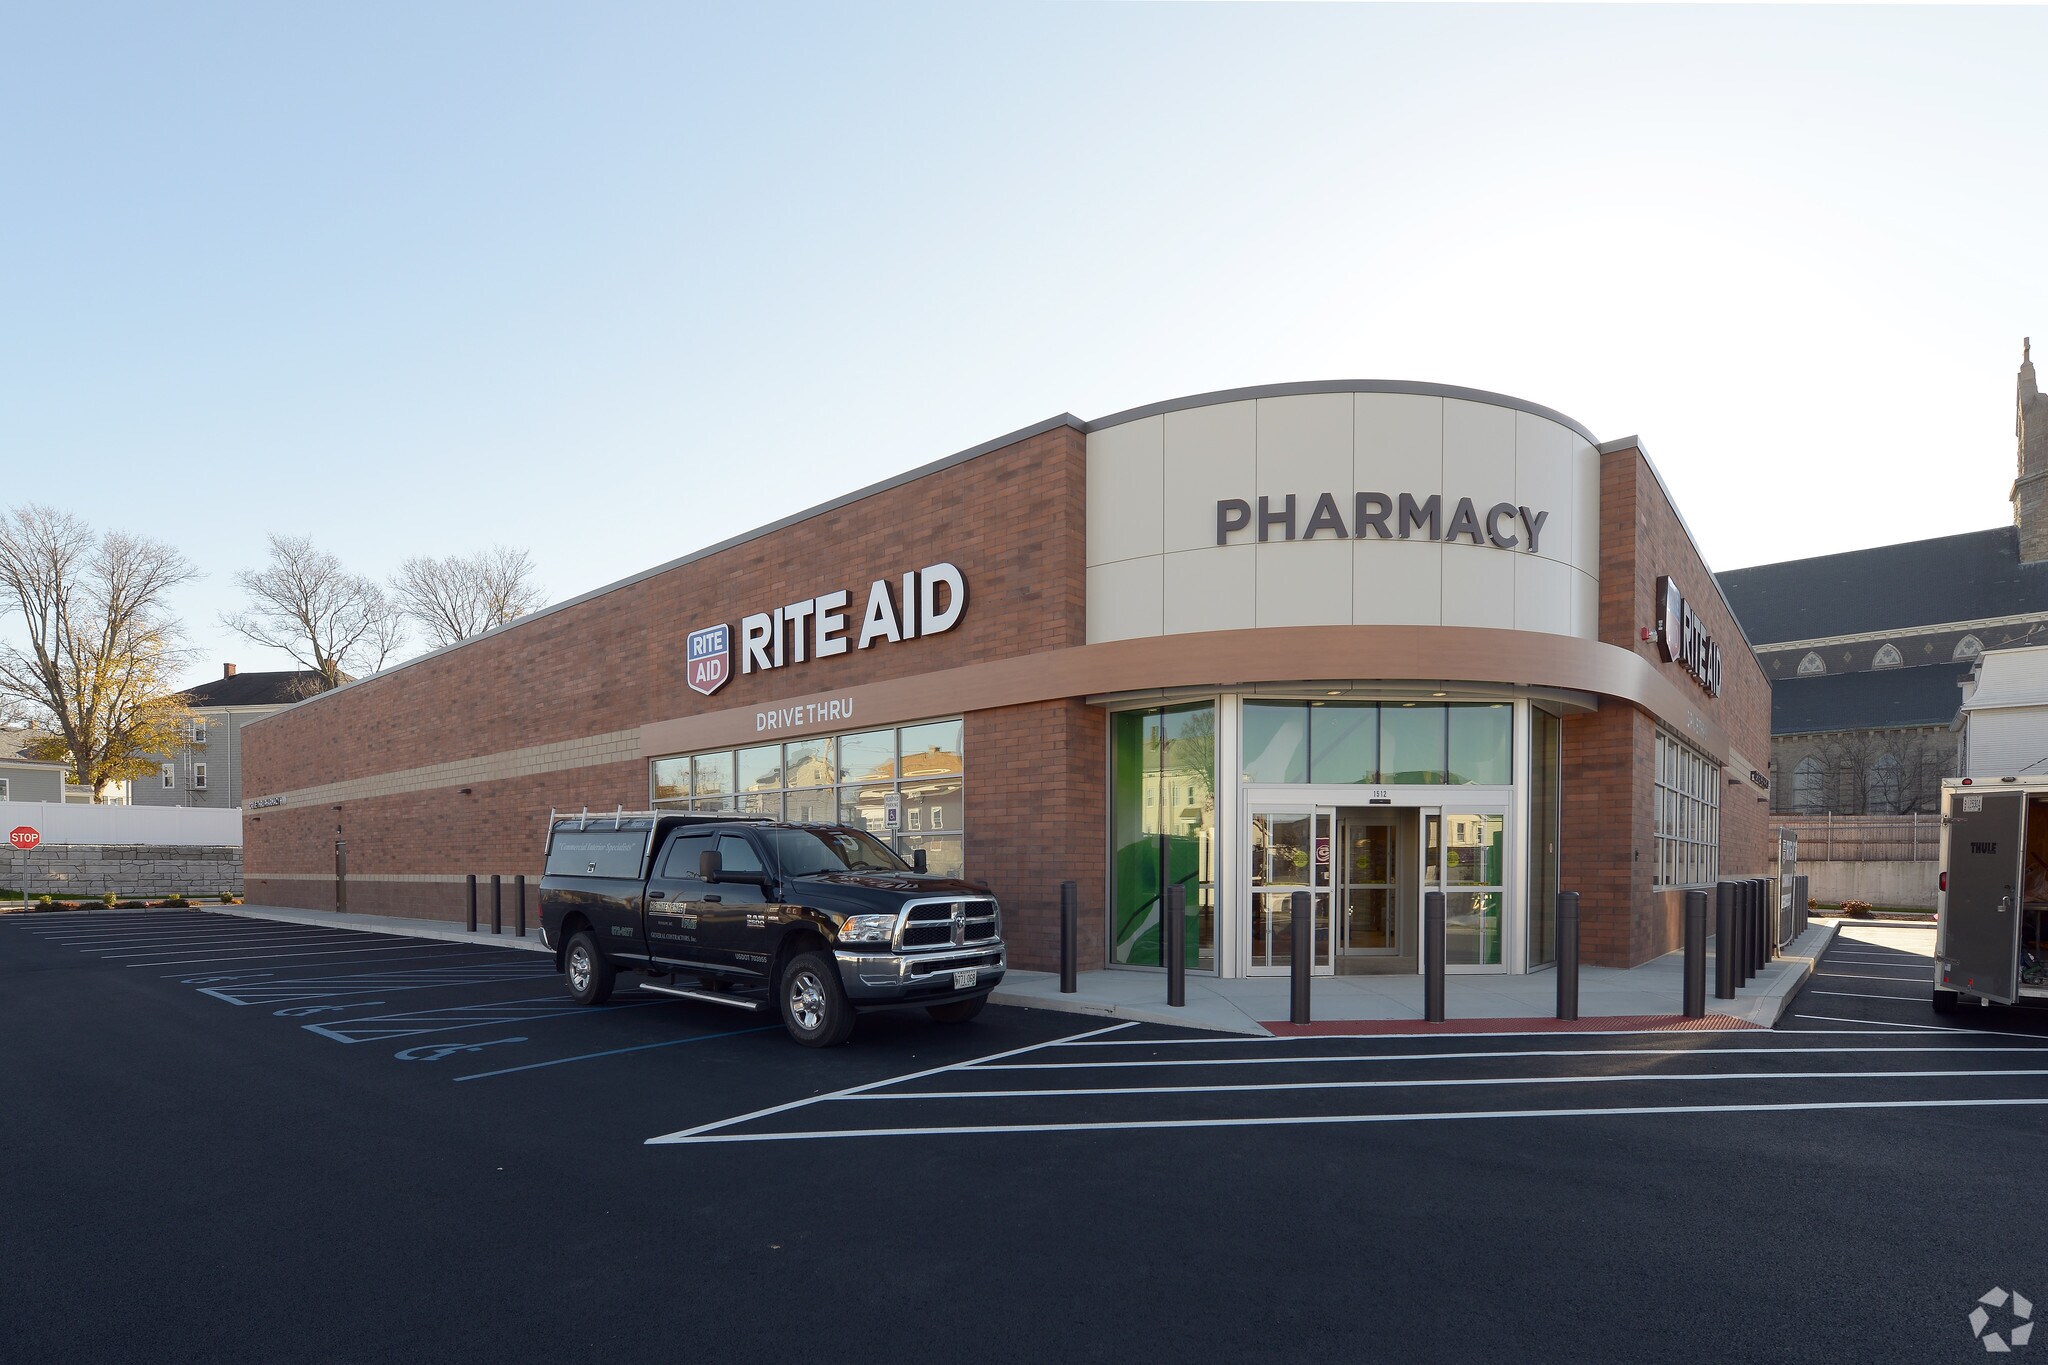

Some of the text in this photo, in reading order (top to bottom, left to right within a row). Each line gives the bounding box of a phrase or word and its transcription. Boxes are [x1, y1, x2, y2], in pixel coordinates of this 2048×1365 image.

[1217, 492, 1549, 553] PHARMACY
[742, 562, 967, 674] RITE AID
[693, 631, 723, 656] RITE
[1682, 598, 1722, 698] RITE AID
[695, 659, 721, 684] AID
[756, 698, 853, 732] DRIVE THRU
[1373, 790, 1387, 798] 1512
[11, 833, 39, 843] STOP
[1970, 841, 1997, 855] THULE
[649, 900, 684, 914] MAINTENANCE
[650, 931, 666, 940] GENERAL
[734, 953, 750, 961] USDOT
